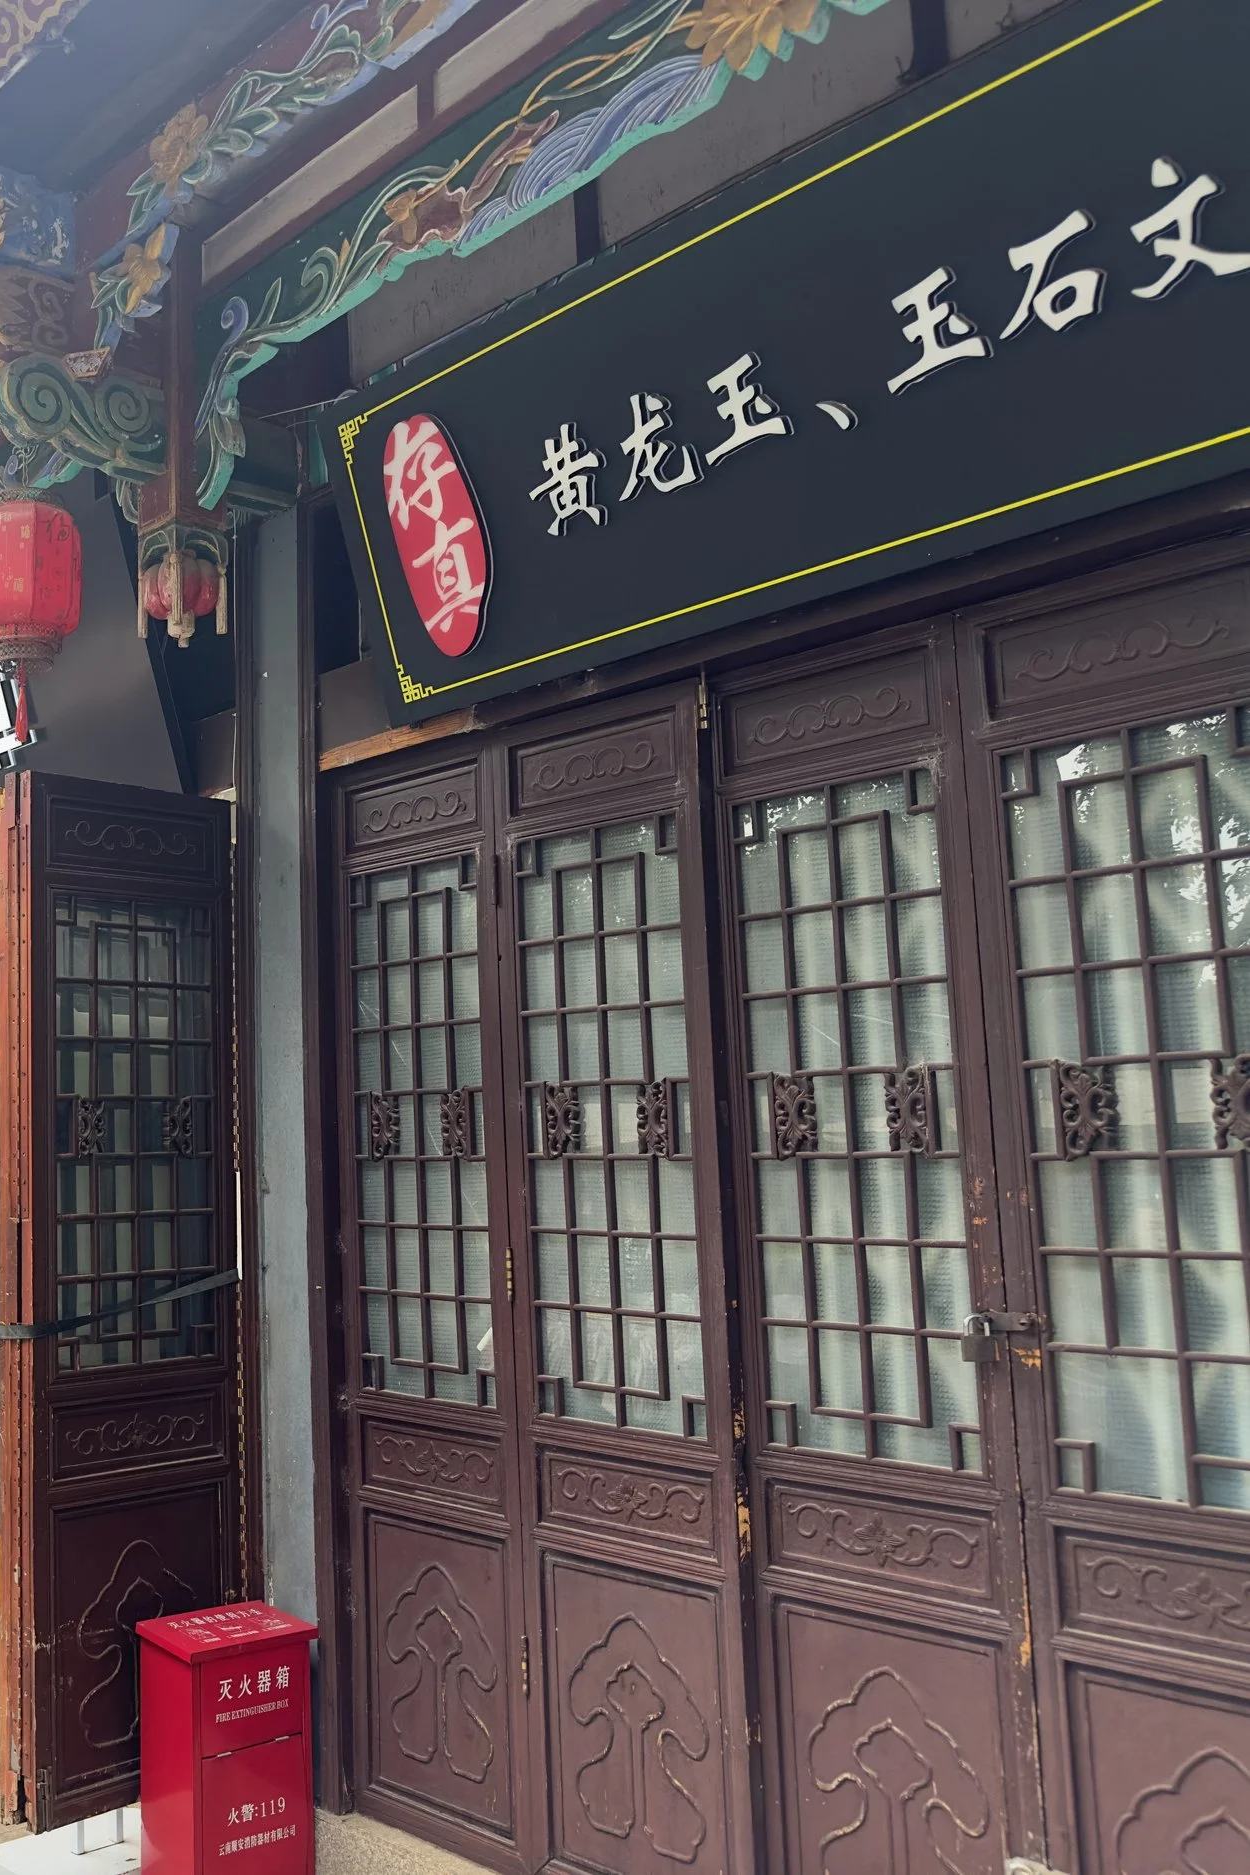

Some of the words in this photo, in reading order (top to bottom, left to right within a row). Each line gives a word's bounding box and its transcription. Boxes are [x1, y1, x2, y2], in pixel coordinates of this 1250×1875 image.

[529, 155, 1250, 537] 黄龙玉、玉石文
[383, 421, 486, 633] 存真
[215, 1711, 231, 1723] FIRE
[231, 1702, 277, 1720] EXTINGUISHER
[276, 1699, 290, 1710] BOX
[217, 1665, 291, 1702] 灭火器箱
